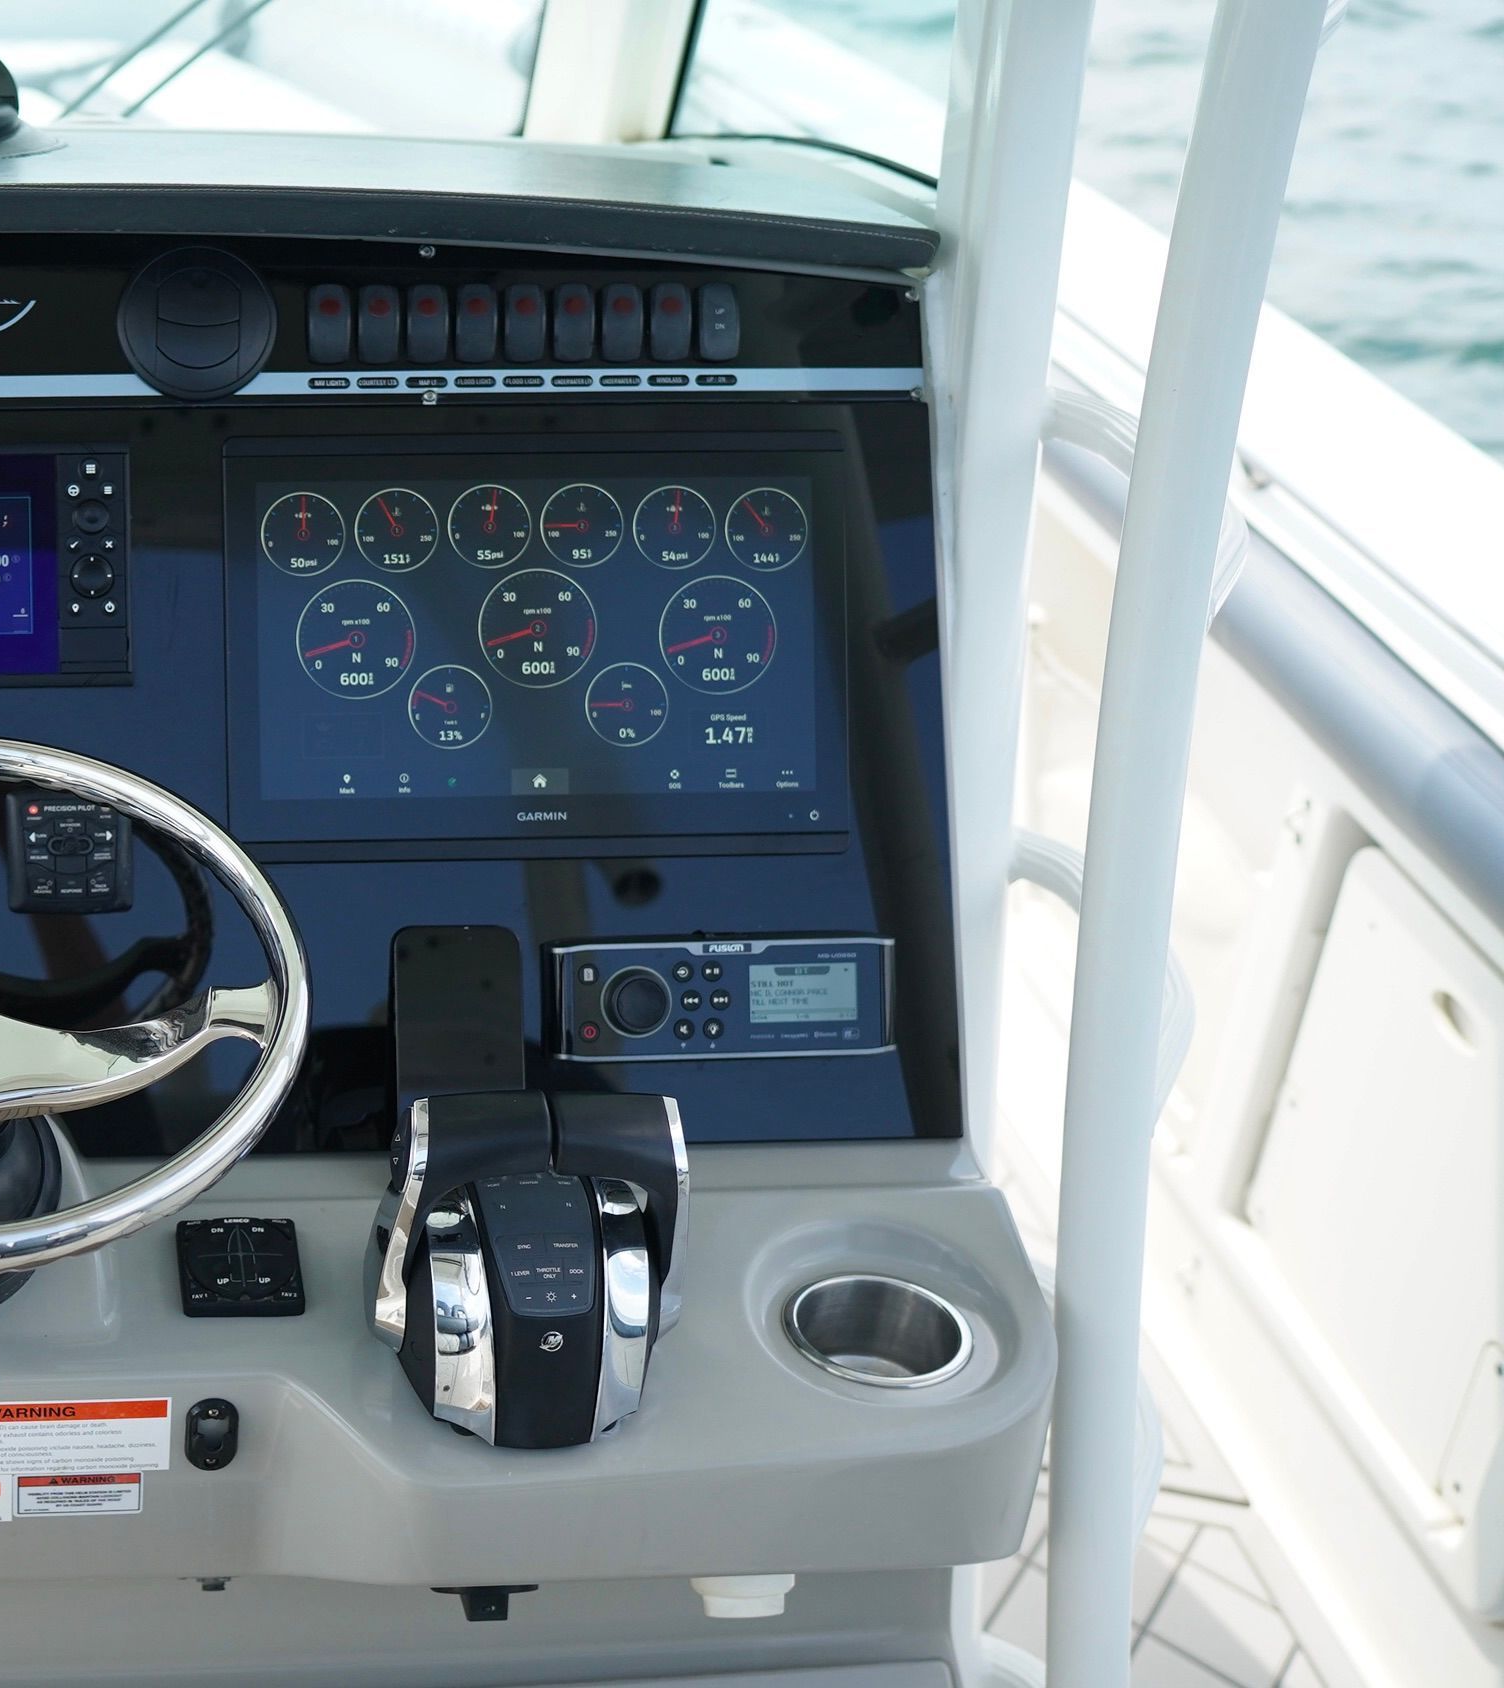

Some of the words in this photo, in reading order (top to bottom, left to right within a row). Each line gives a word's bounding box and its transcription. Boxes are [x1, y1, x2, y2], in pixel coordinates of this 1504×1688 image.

[503, 592, 516, 602] 30
[558, 592, 571, 602] 60
[321, 604, 334, 613] 30
[377, 603, 390, 612] 60
[683, 599, 696, 609] 30
[738, 599, 751, 608] 60
[534, 642, 543, 652] N
[567, 647, 579, 657] 90
[352, 653, 361, 663] N
[497, 649, 504, 659] 0
[714, 648, 723, 659] N
[746, 653, 759, 663] 90
[315, 660, 322, 669] 0
[385, 658, 398, 667] 90
[678, 656, 684, 665] 0
[522, 662, 549, 674] 600
[340, 673, 368, 686] 600
[702, 668, 729, 681] 600
[726, 714, 747, 722] Speed
[439, 731, 463, 741] 13%
[619, 728, 635, 738] 0%
[705, 727, 747, 745] 1.47
[669, 782, 682, 790] SOS
[776, 781, 799, 789] Options
[339, 787, 355, 795] Mark
[517, 811, 567, 822] GARMIN
[709, 944, 744, 952] FUSION
[61, 1476, 116, 1484] WARNING
